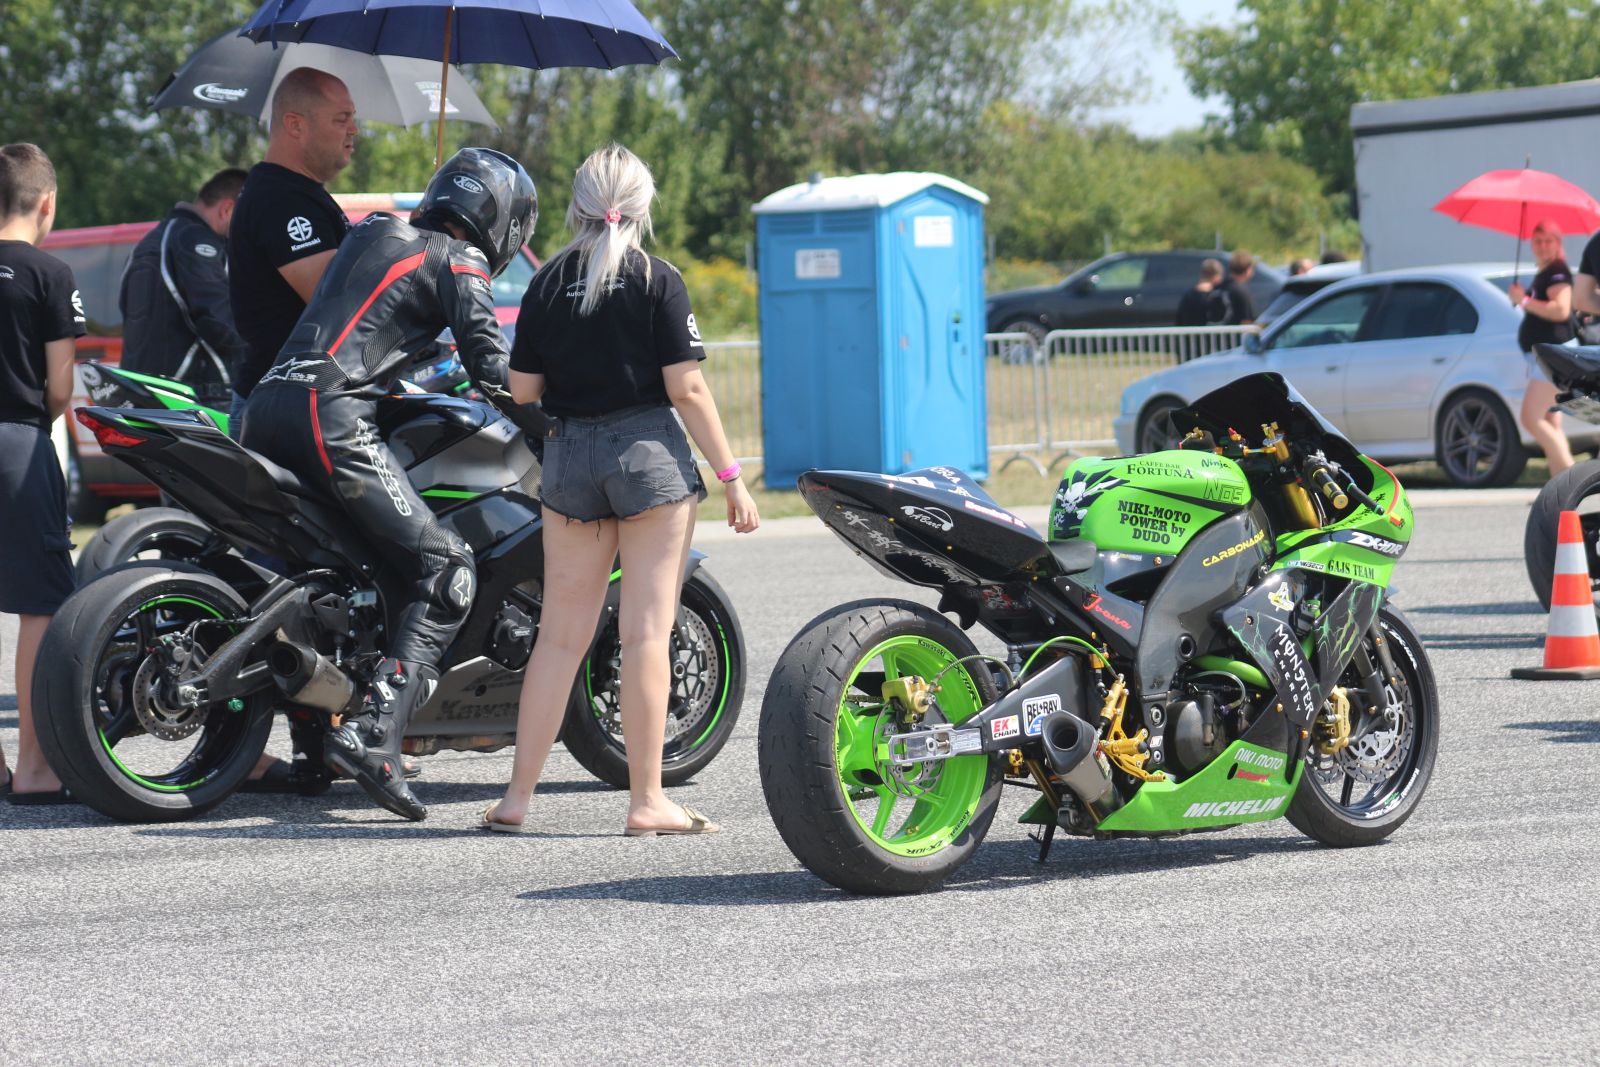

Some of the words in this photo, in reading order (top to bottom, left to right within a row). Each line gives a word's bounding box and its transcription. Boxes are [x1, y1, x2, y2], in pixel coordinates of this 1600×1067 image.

[1127, 464, 1195, 480] FORTUNA
[1139, 460, 1164, 468] CAFFE
[1201, 459, 1231, 469] Ninja
[1117, 500, 1191, 523] NIKI-MOTO
[1120, 513, 1168, 532] POWER
[1171, 523, 1186, 537] by
[1132, 528, 1170, 545] DUDO
[1347, 531, 1403, 555] ZX-10R
[1327, 559, 1351, 574] GAJS
[1352, 565, 1375, 580] TEAM
[918, 639, 945, 657] Kawasaki
[1274, 649, 1301, 711] ENERGY
[993, 719, 1010, 733] EK
[993, 729, 1018, 738] CHAIN
[1234, 748, 1257, 764] NIKI
[1254, 754, 1283, 770] MOTO
[1183, 795, 1287, 817] MICHELIN
